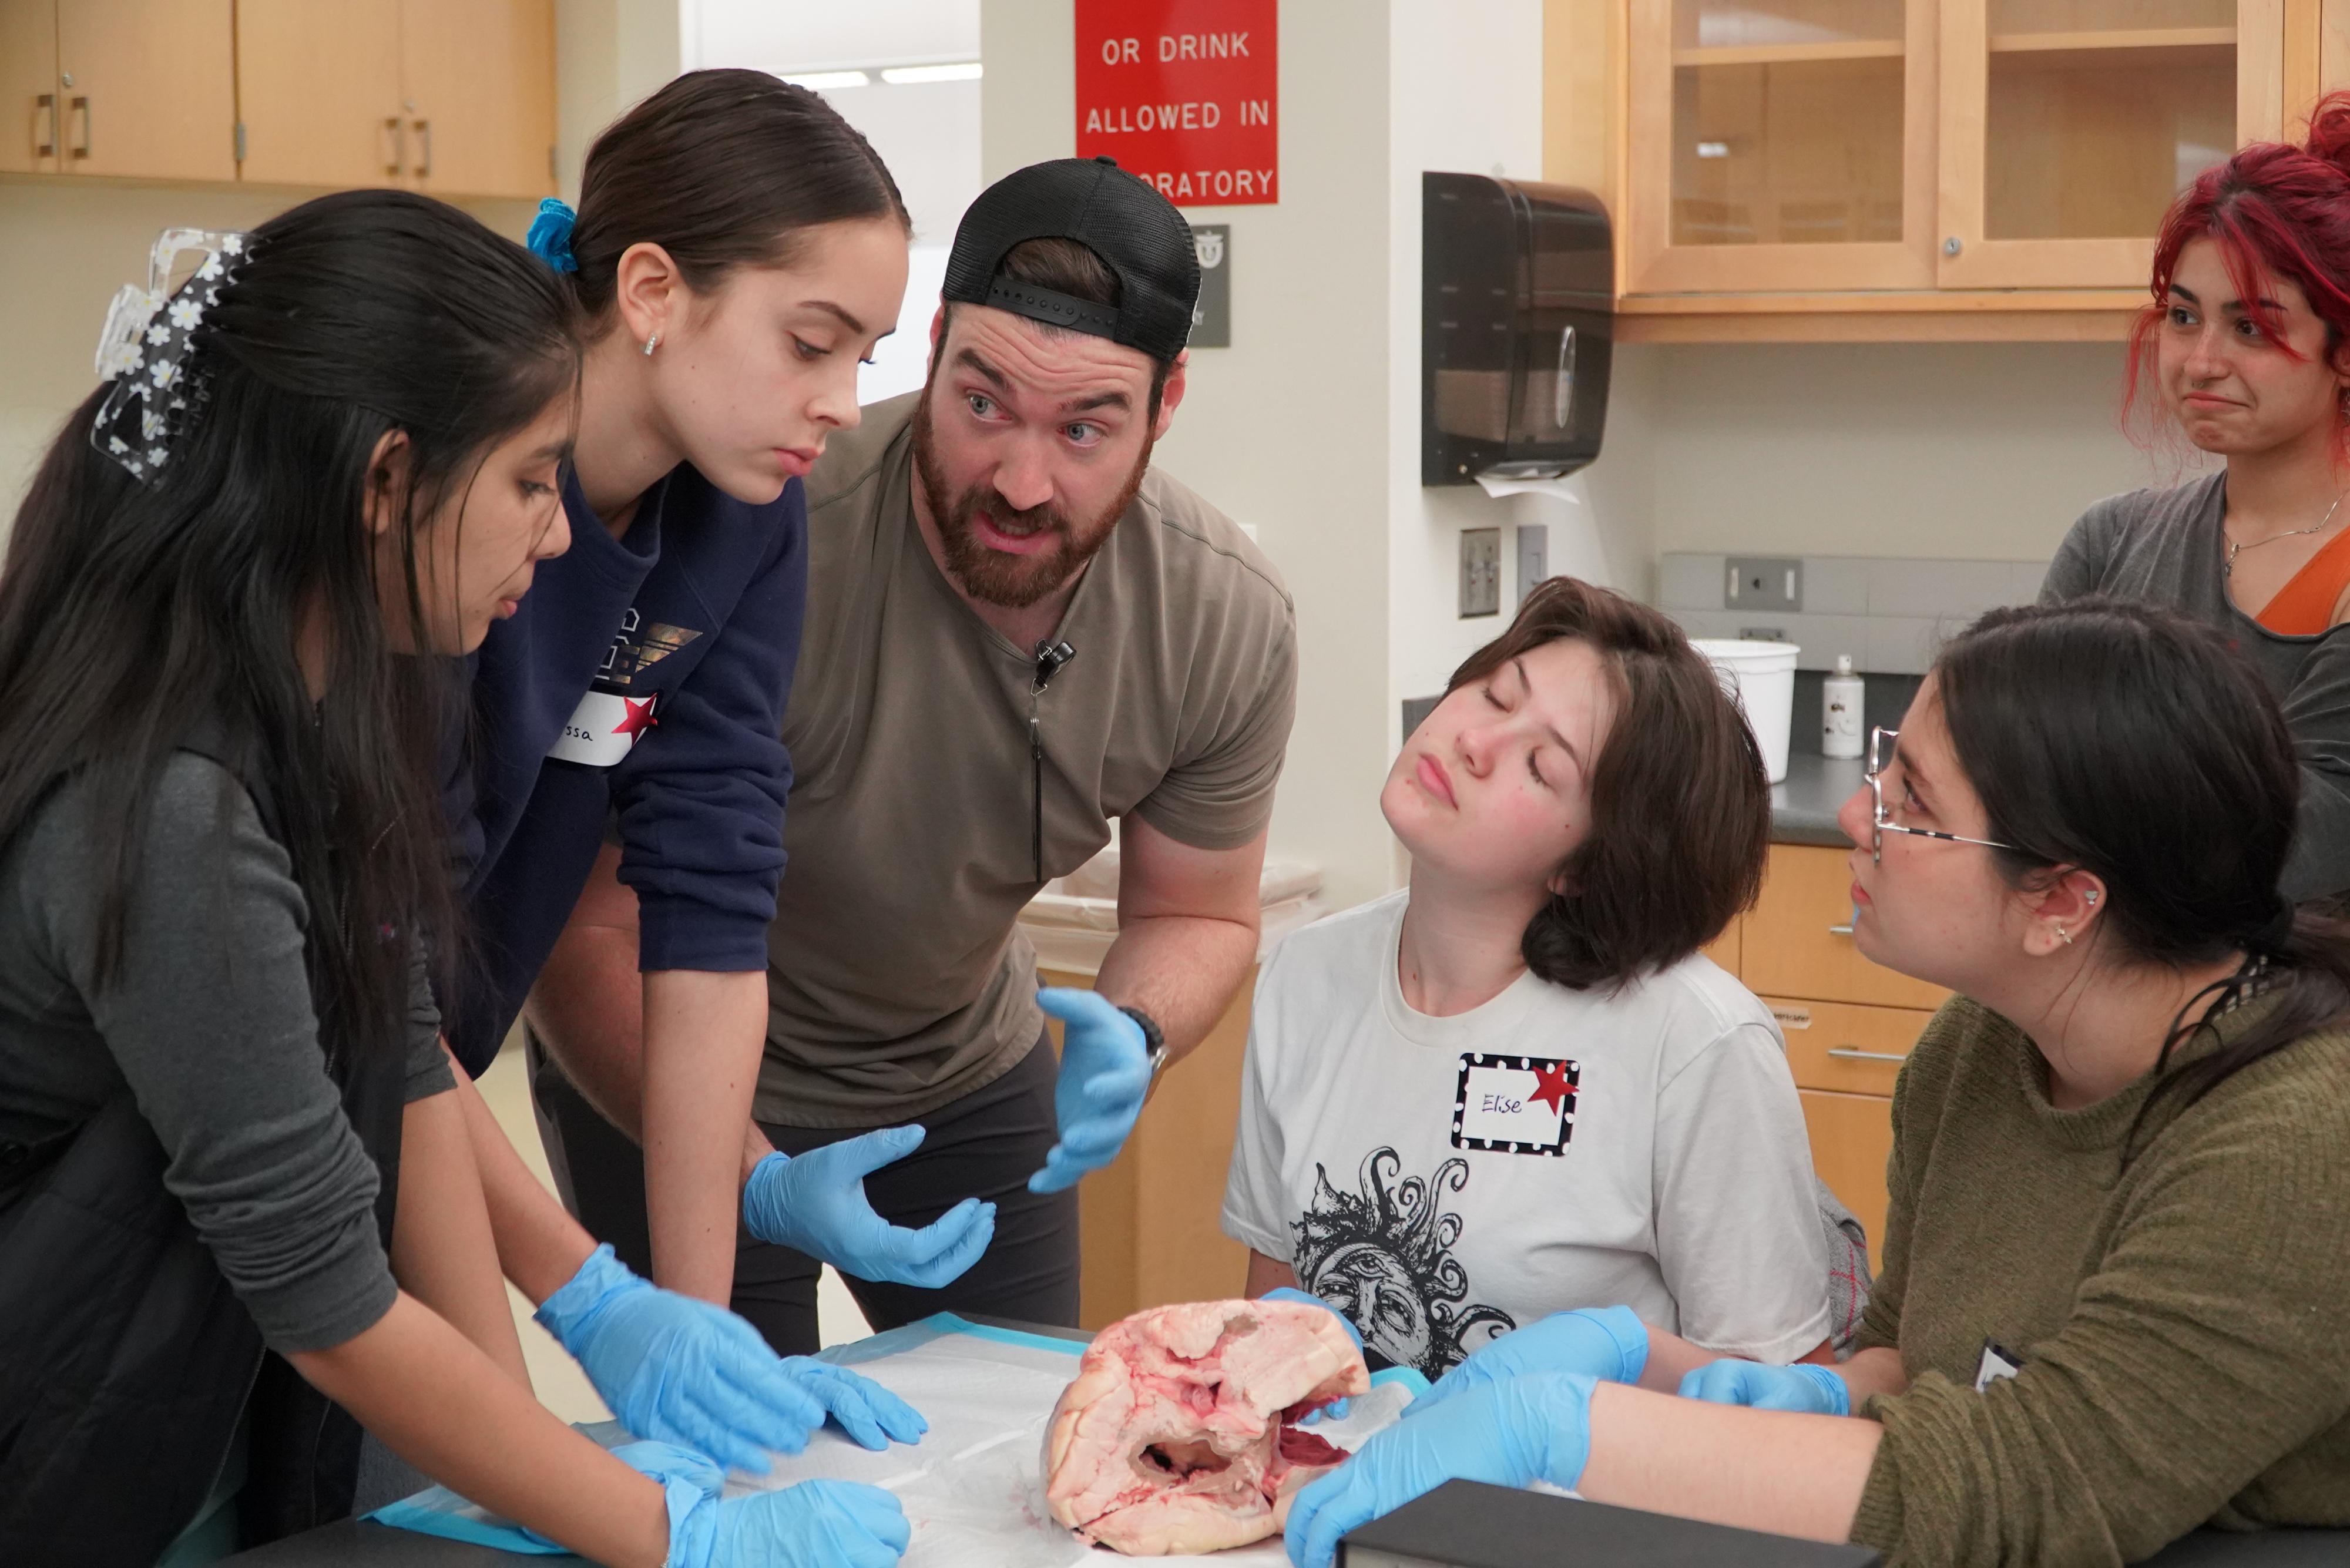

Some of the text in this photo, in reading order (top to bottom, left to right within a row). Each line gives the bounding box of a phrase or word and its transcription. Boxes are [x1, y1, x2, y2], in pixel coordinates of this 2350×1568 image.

[1102, 32, 1250, 65] OR DRINK
[1085, 99, 1269, 134] ALLOWED IN
[1482, 1093, 1522, 1113] Elise
